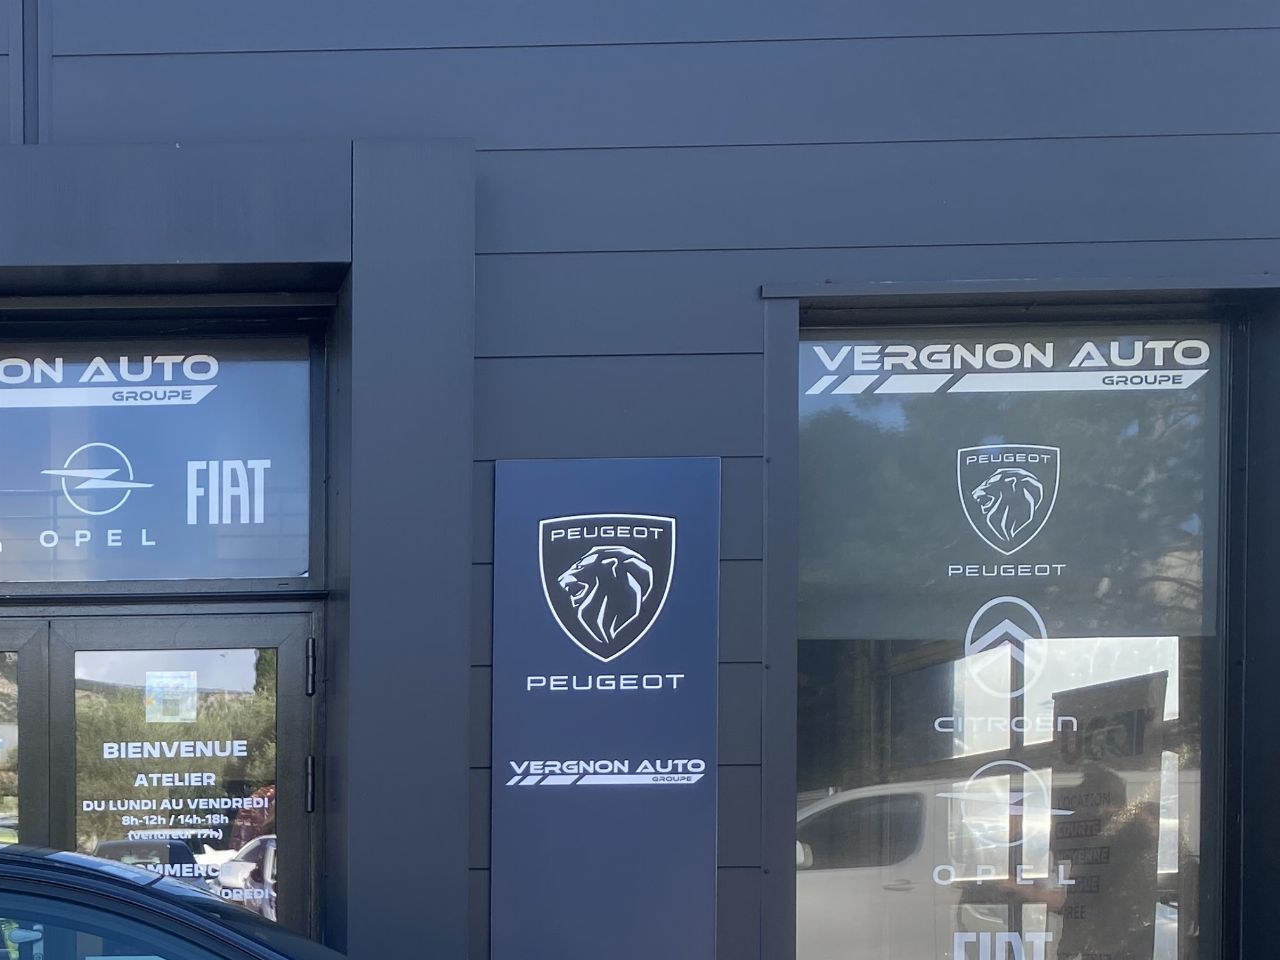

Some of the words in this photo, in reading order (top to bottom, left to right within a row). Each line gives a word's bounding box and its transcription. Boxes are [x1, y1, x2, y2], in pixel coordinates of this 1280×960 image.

[812, 341, 1054, 371] VERGNON
[1068, 340, 1210, 367] AUTO
[78, 354, 219, 383] AUTO
[1102, 375, 1183, 386] GROUPE
[111, 389, 193, 402] GROUPE
[966, 454, 1051, 465] PEUGEOT
[186, 459, 271, 525] FIAT
[39, 528, 156, 547] OPEL
[551, 526, 664, 542] PEUGEOT
[949, 564, 1066, 576] PEUGEOT
[527, 674, 685, 691] PEUGEOT
[103, 740, 248, 759] BIENVENUE
[509, 760, 629, 774] VERGNON
[635, 759, 705, 773] AUTO
[134, 772, 216, 787] ATELIER
[82, 801, 105, 812] DU
[109, 799, 156, 811] LUNDI
[160, 799, 183, 810] AU
[186, 797, 268, 809] VENDREDI
[122, 815, 166, 827] 8h-12h
[178, 814, 229, 825] 14h-18h
[933, 865, 1075, 886] OPEL
